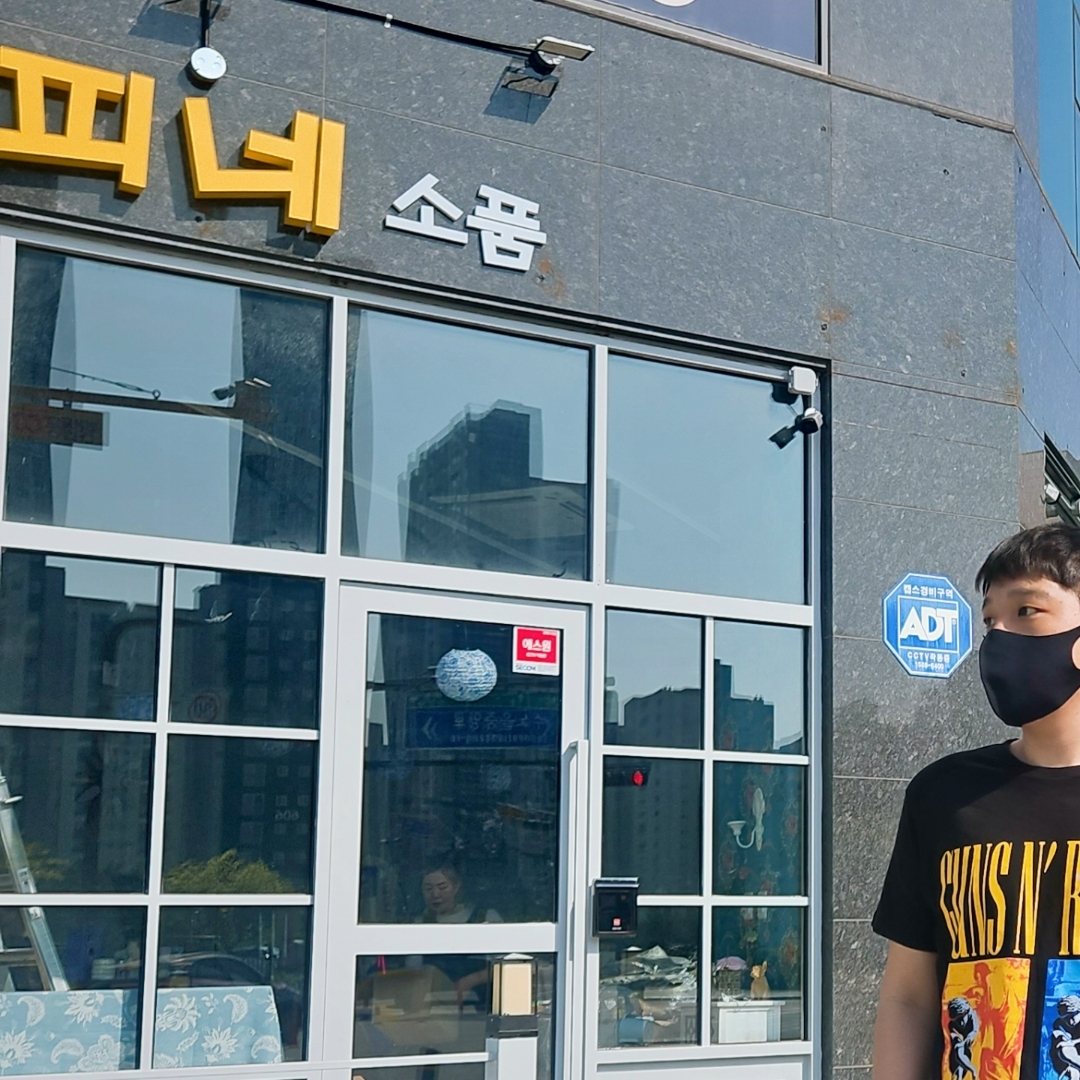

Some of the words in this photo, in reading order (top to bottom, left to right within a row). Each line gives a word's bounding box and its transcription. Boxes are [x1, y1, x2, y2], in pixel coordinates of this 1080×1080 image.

[385, 172, 547, 272] 소품
[903, 584, 954, 599] 캡스경비구역
[900, 606, 958, 643] ADT
[521, 638, 552, 653] 에스원
[940, 841, 1013, 960] GUNS
[1013, 841, 1058, 955] N'
